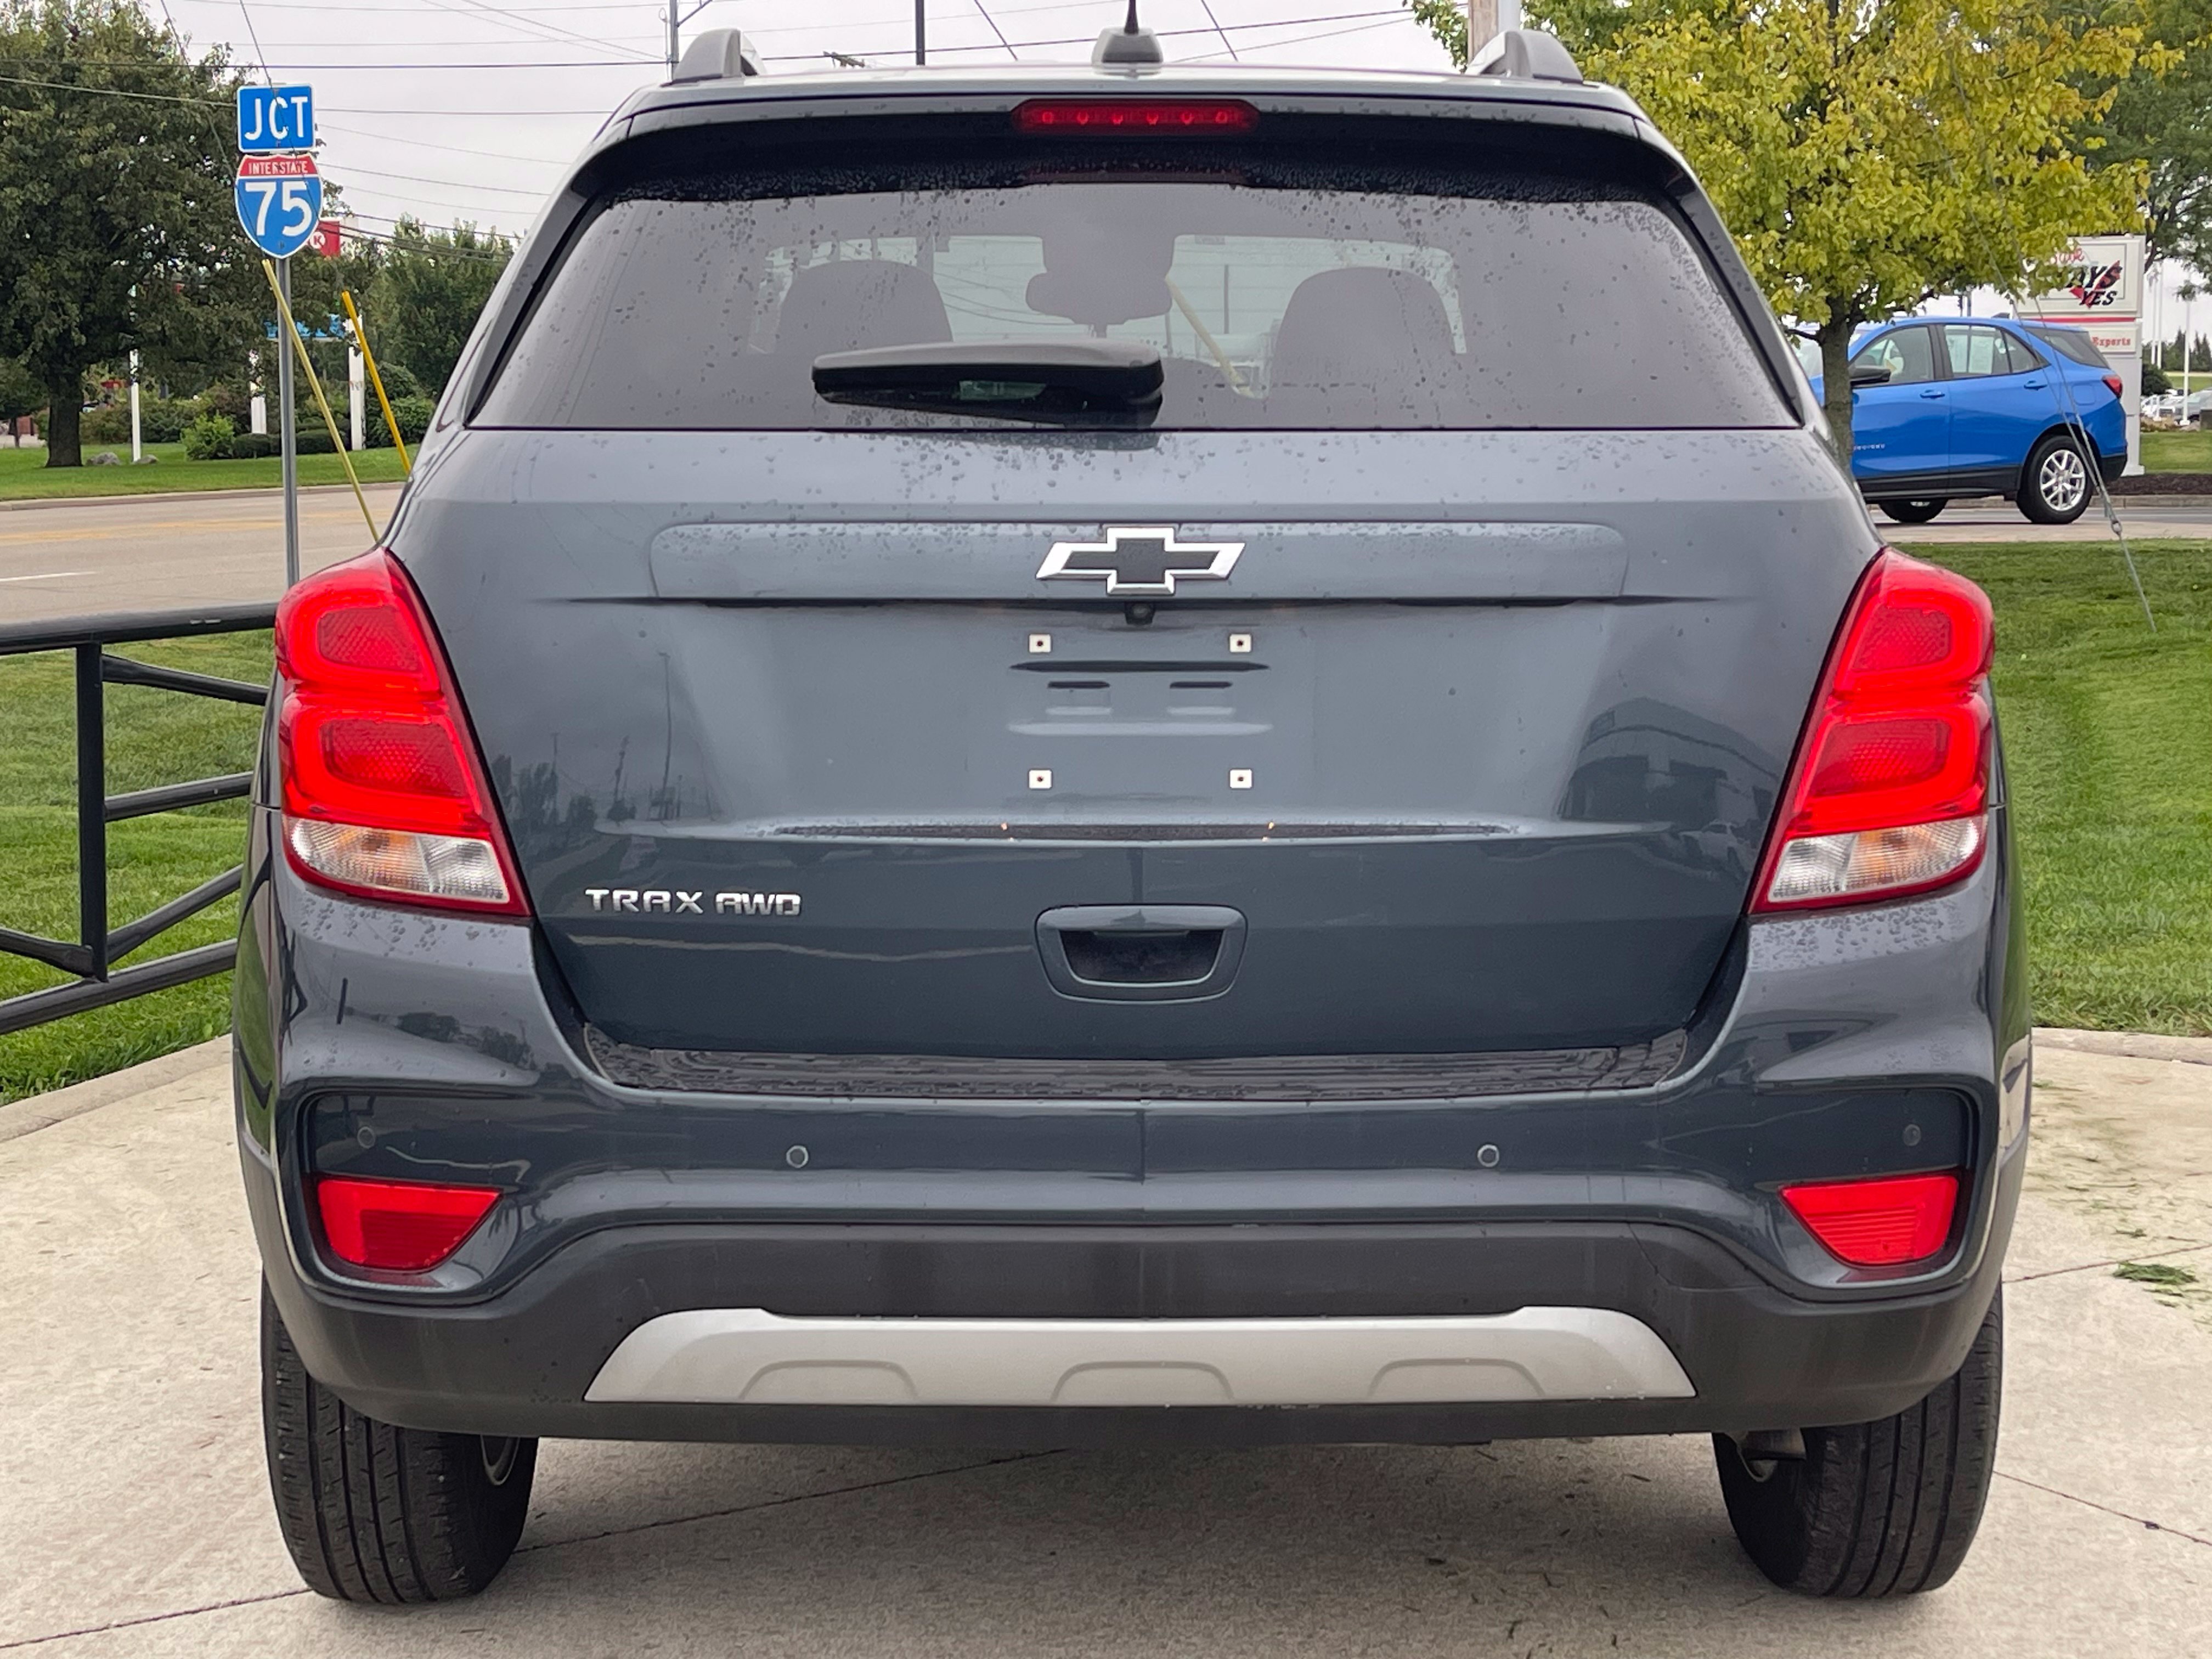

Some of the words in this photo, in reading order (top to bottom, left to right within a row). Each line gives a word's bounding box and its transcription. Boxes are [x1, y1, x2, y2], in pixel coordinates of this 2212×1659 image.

[245, 96, 308, 140] JCT
[249, 161, 308, 174] INTERSTATE
[245, 181, 312, 236] 75
[313, 235, 324, 248] K
[2079, 290, 2118, 306] YES
[585, 889, 703, 914] TRAX
[715, 893, 802, 916] AWD
